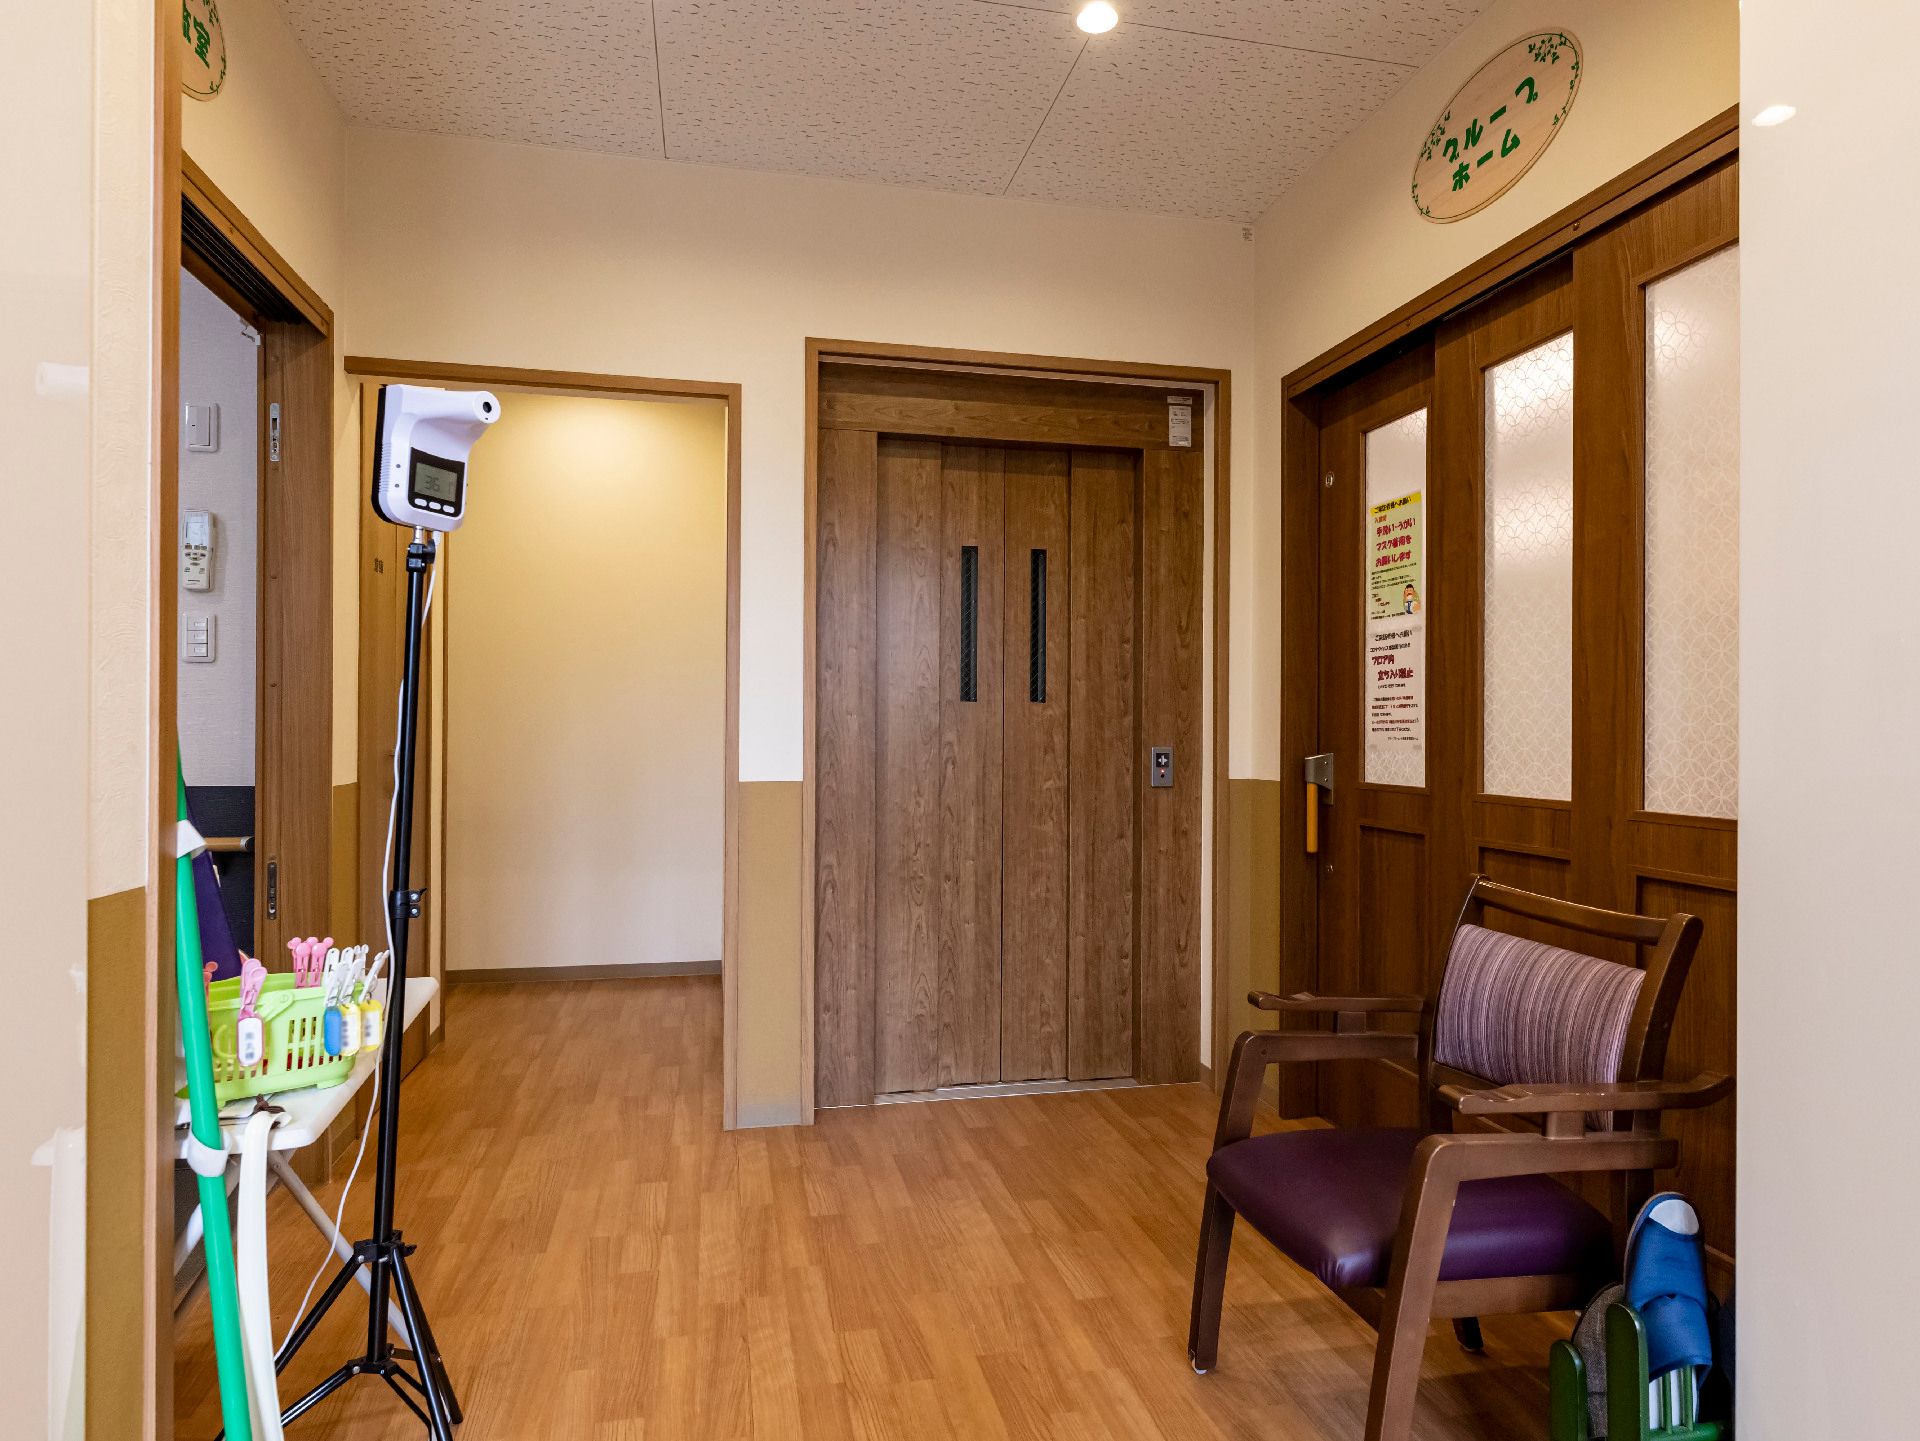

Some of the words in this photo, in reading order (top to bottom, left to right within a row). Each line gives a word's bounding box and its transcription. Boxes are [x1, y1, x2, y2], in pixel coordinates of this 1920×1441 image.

[1442, 76, 1539, 164] グループ
[1452, 128, 1521, 192] ホーム
[1376, 534, 1412, 552] マスク着用を
[1375, 549, 1412, 568] お願いします
[1371, 653, 1395, 666] フロア内
